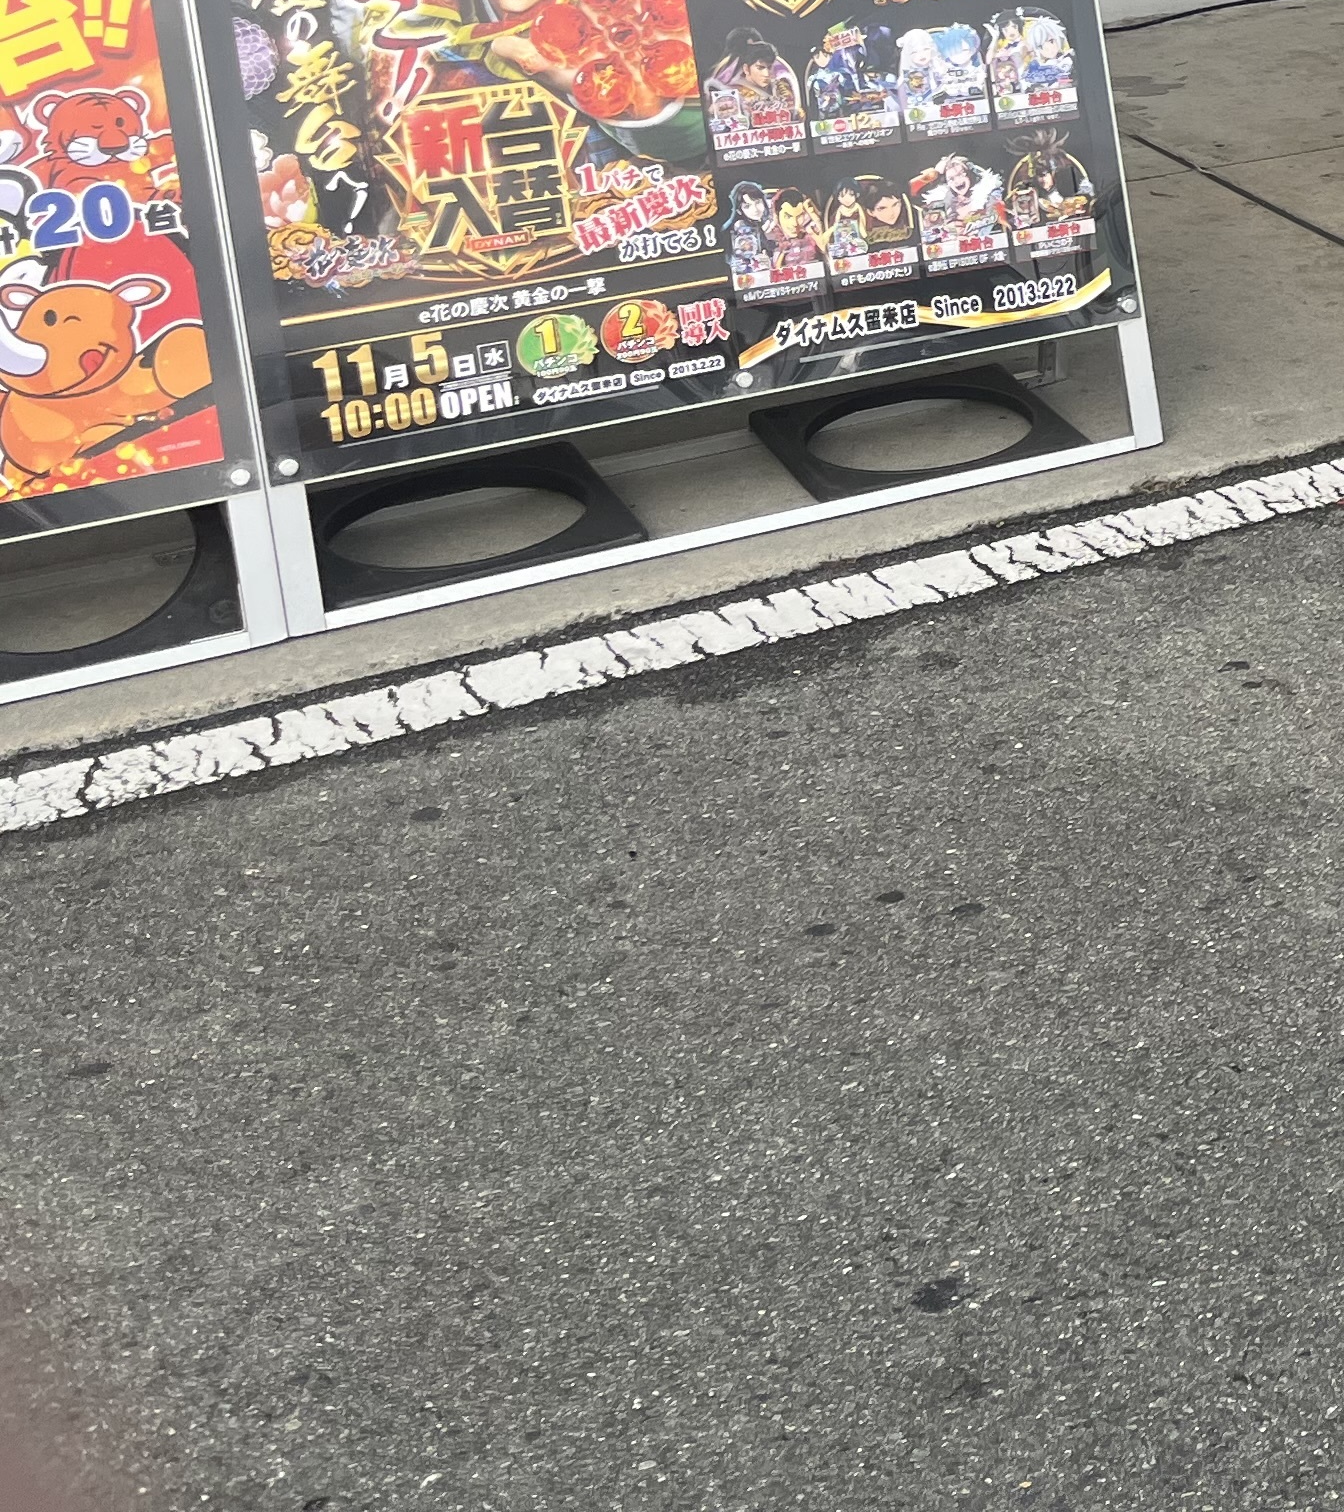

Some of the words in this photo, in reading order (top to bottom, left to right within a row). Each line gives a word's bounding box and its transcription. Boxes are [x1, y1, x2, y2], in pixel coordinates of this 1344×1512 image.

[577, 164, 663, 195] 1パチで
[473, 233, 527, 250] DYNAM
[934, 296, 980, 318] Since
[995, 277, 1076, 308] 2013.2.22
[312, 331, 477, 402] 11月5日
[633, 371, 662, 383] Since
[671, 359, 722, 376] 2013.2.22
[320, 388, 438, 443] 10:00
[440, 381, 514, 420] OPEN
